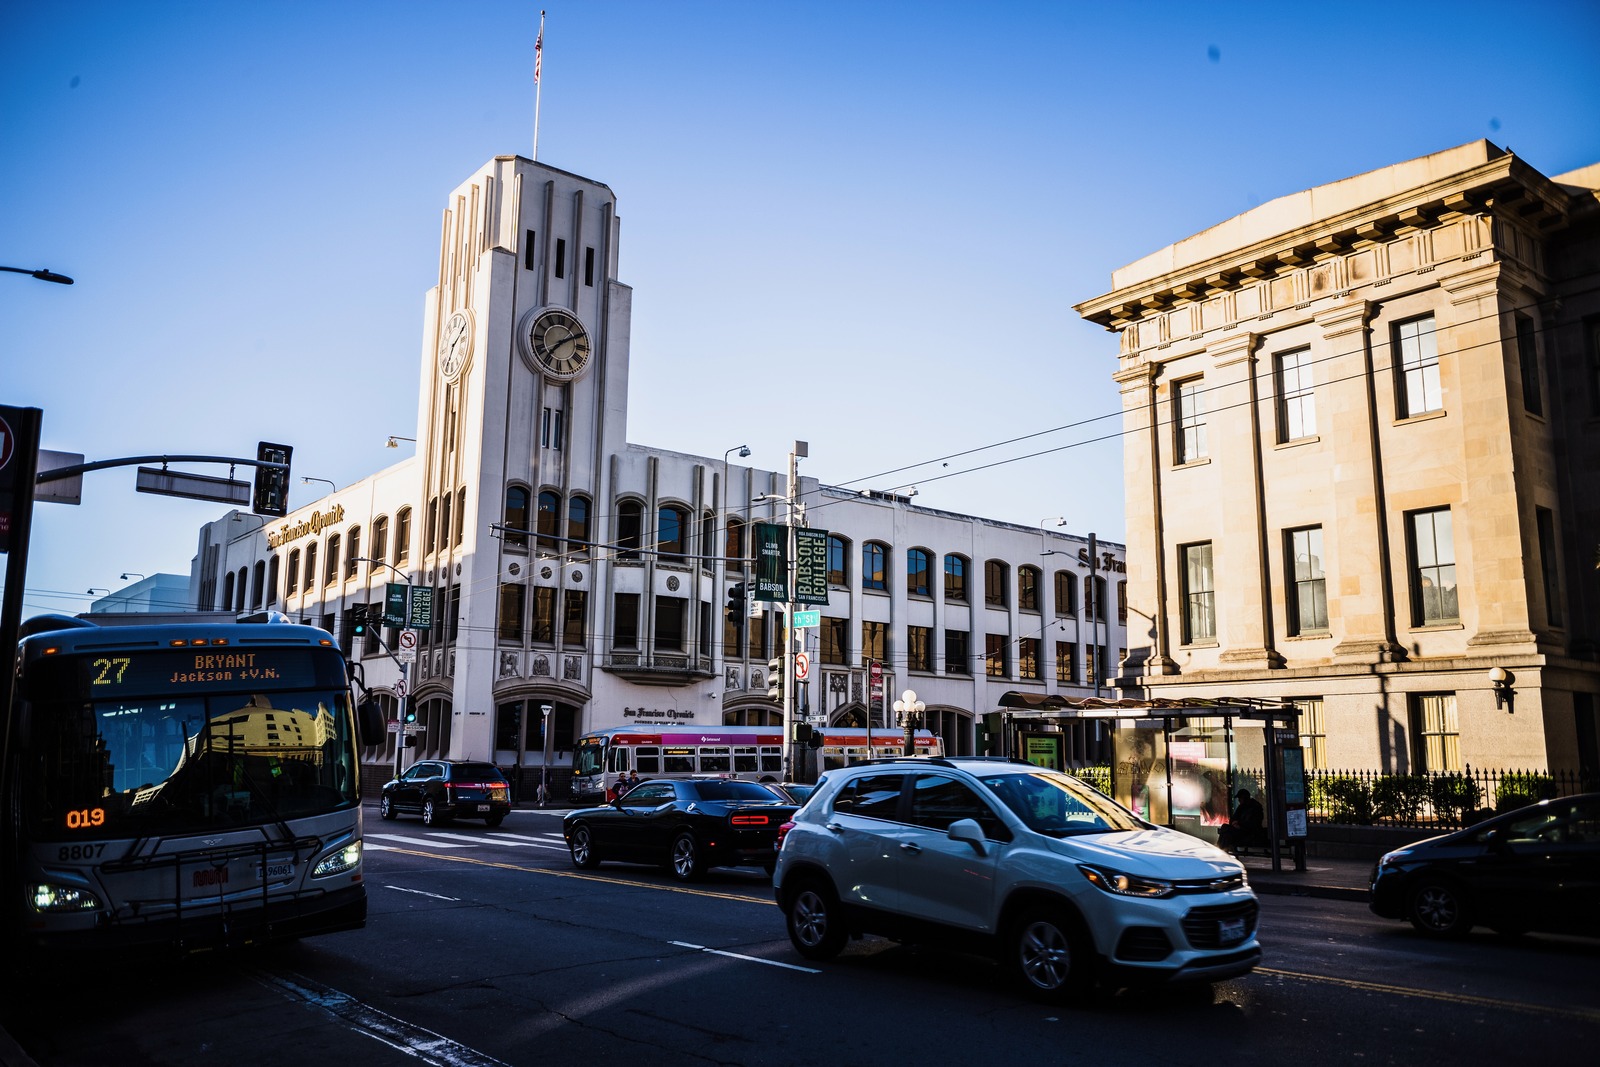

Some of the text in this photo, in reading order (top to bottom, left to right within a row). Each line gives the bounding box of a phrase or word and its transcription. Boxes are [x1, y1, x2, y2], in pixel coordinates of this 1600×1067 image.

[267, 504, 345, 552] San Francisco Chronicle
[798, 537, 812, 594] BABSON
[813, 538, 826, 596] COLLEGE
[760, 582, 784, 592] BABSON
[412, 590, 423, 624] BABSON
[422, 591, 432, 625] COLLEGE
[806, 615, 814, 624] St
[194, 653, 256, 670] BRYANT
[93, 658, 131, 685] 27
[170, 668, 280, 683] Jackson +V.N.
[624, 707, 695, 719] San Francisco Chronicle
[66, 808, 105, 828] 019
[58, 844, 109, 862] 8807
[258, 865, 292, 878] 196061
